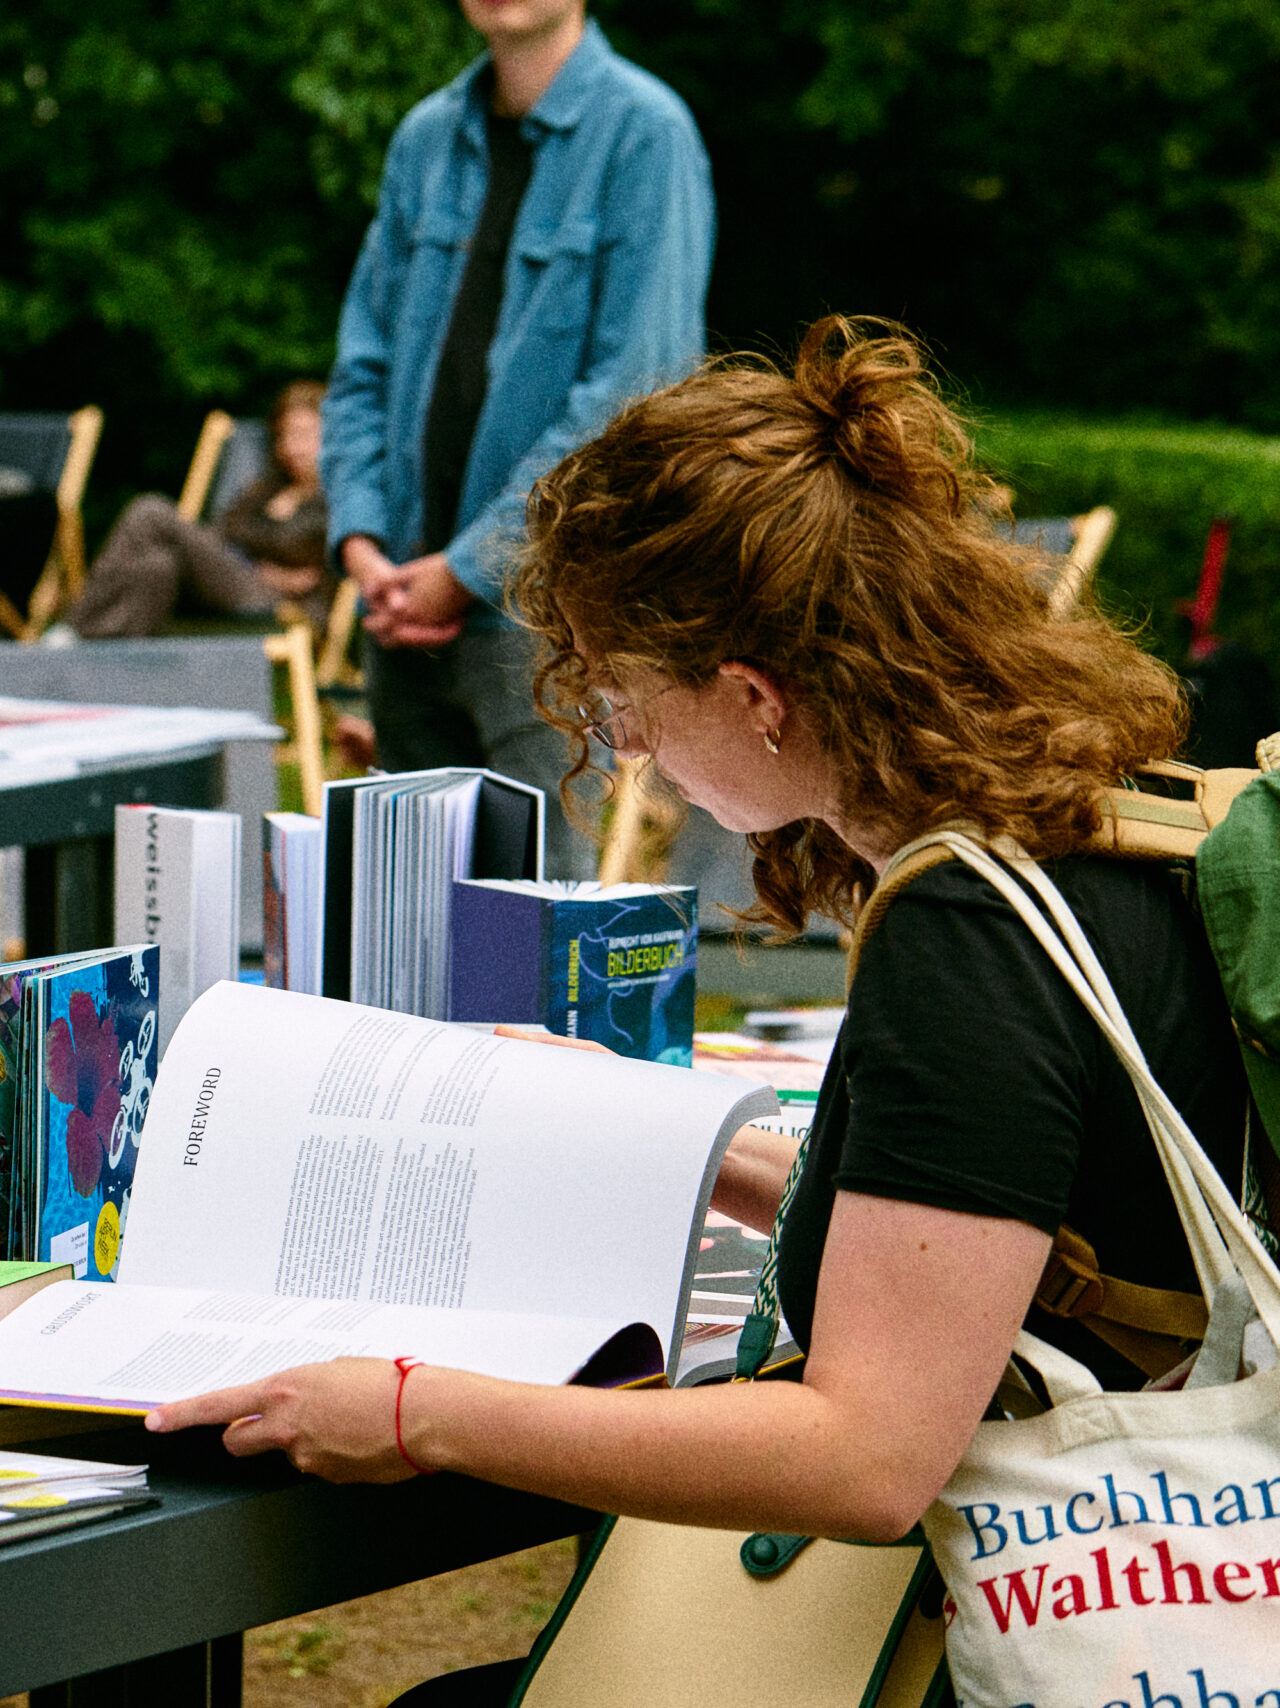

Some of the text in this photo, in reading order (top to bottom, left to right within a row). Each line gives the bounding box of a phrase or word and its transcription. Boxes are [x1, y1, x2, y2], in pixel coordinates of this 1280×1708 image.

[567, 940, 580, 1002] BILDERBUCH
[607, 944, 684, 977] BILDERBUCH
[183, 1066, 222, 1167] FOREWORD
[41, 1291, 101, 1336] GRUSSWORT
